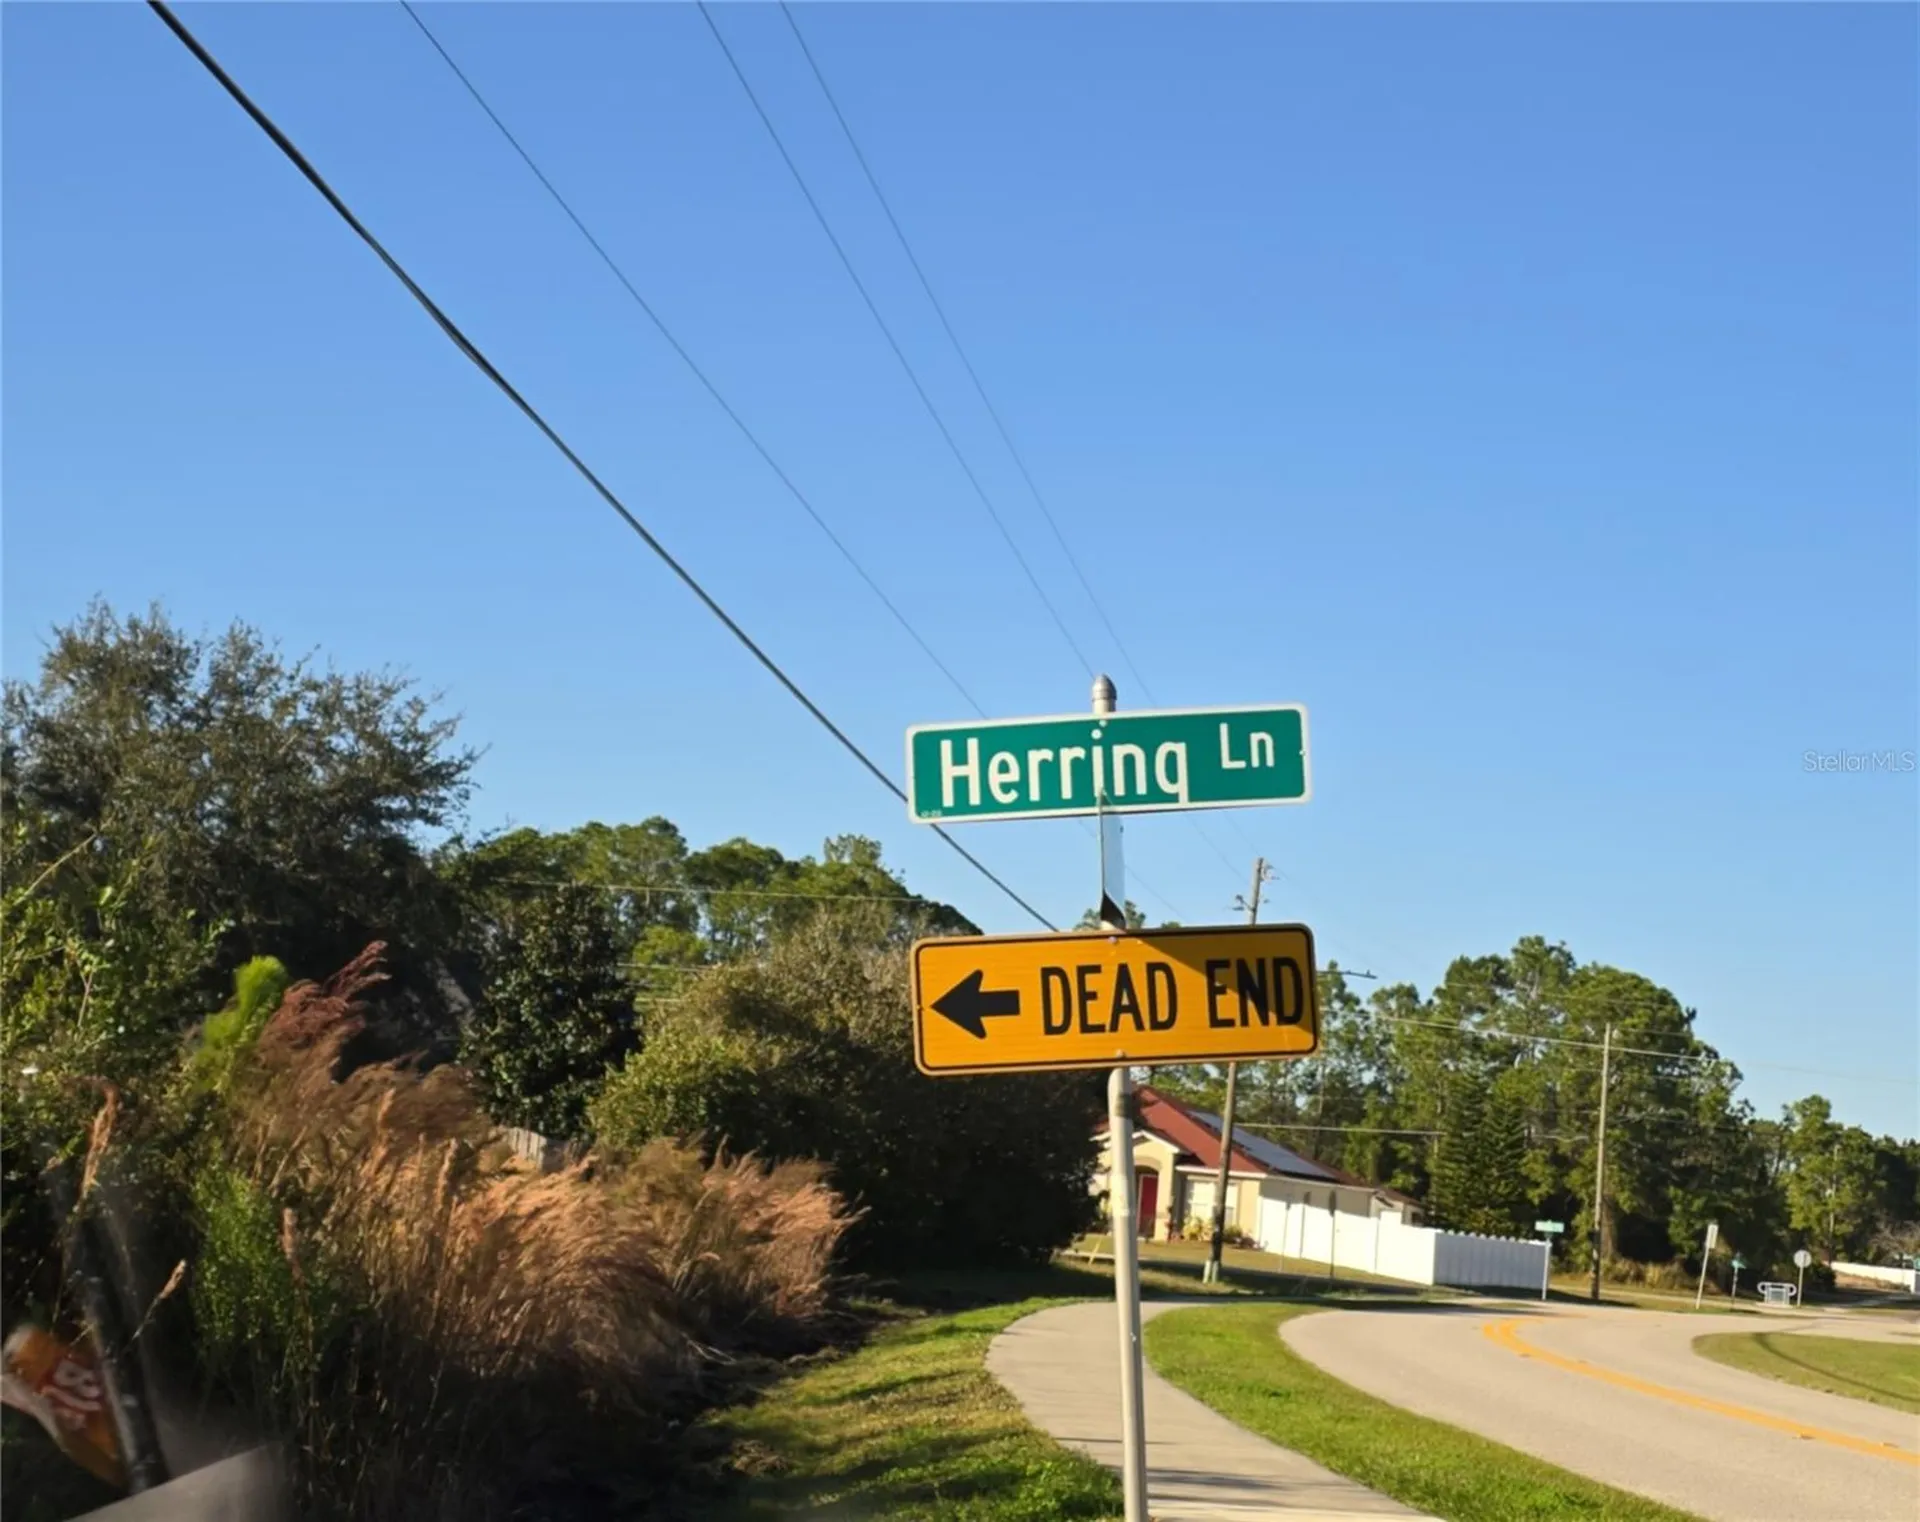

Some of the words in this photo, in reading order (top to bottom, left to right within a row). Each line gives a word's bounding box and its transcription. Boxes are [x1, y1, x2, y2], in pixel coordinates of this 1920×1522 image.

[1219, 723, 1275, 769] Ln
[1041, 962, 1178, 1035] DEAD
[1204, 956, 1305, 1028] END
